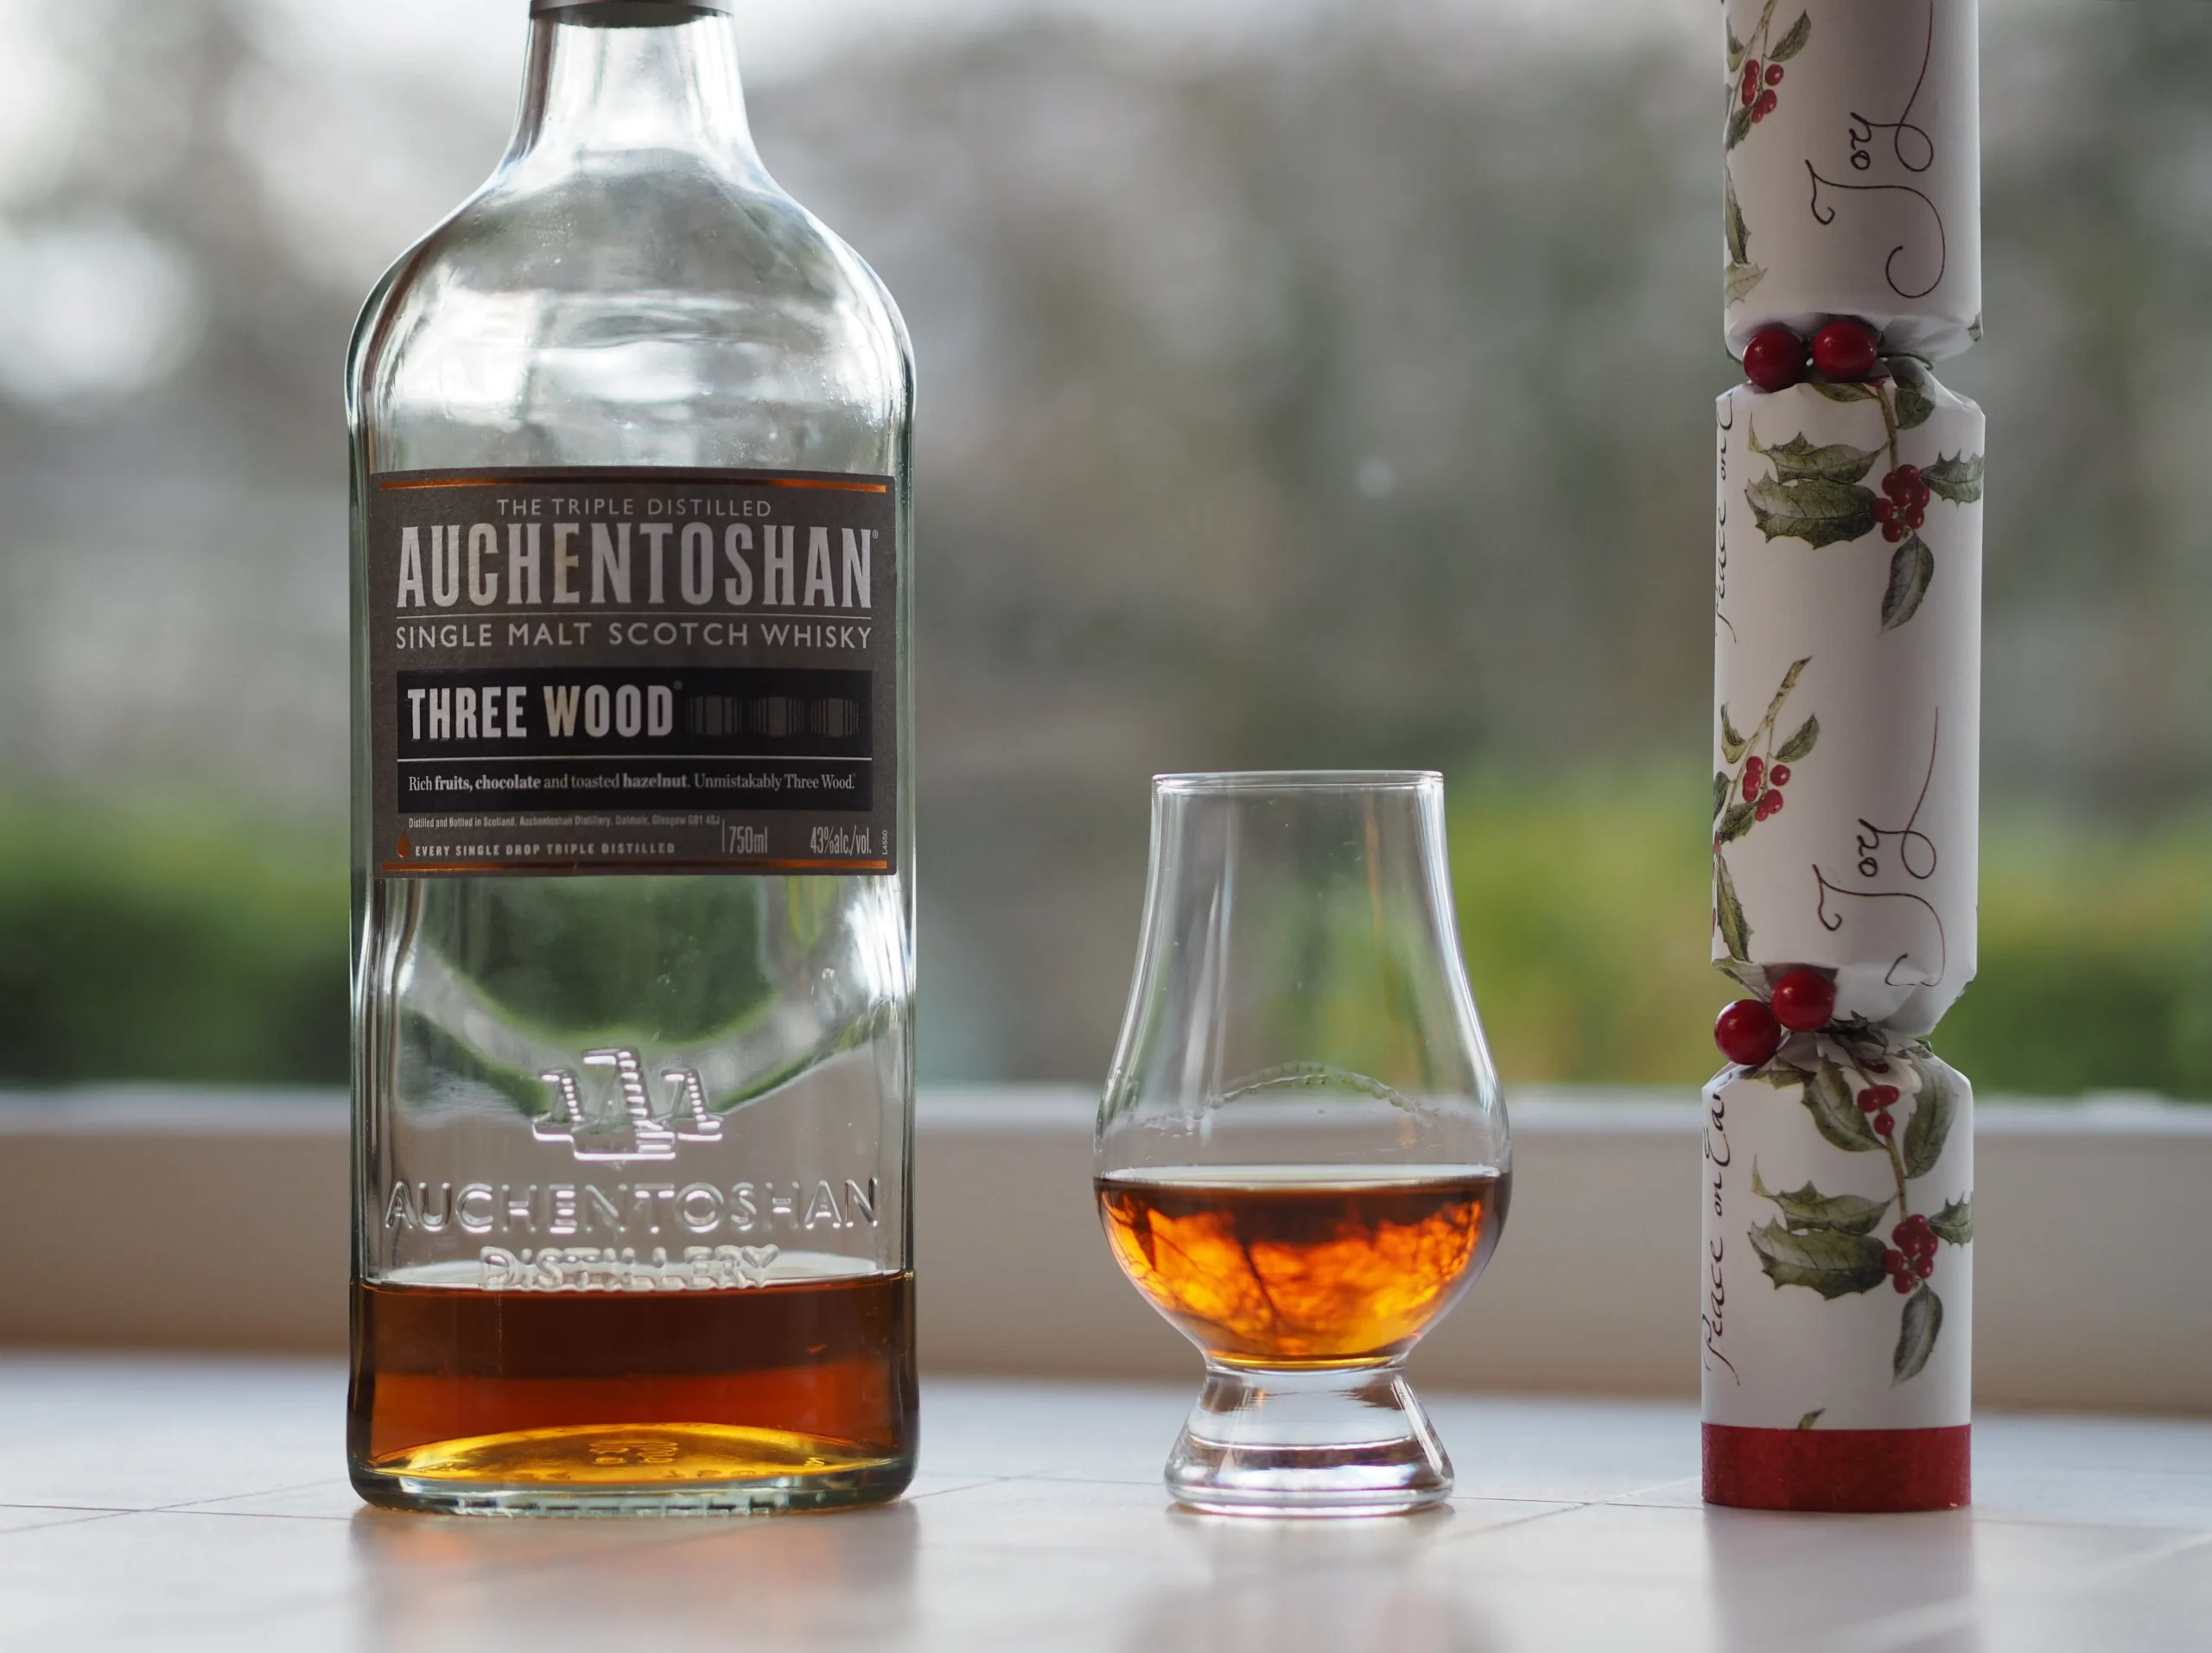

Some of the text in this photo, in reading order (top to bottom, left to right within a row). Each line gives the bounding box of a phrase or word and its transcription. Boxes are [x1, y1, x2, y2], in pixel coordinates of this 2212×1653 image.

[497, 498, 772, 518] THE TRIPLE DISTILLED
[396, 522, 874, 608] AUCHENTOSHAN
[396, 622, 872, 650] SINGLE MALT SCOTCH WHISKY
[407, 683, 674, 741] THREE WOOD
[409, 776, 432, 791] Rich
[435, 775, 474, 792] fruits,
[475, 774, 541, 790] chocolate
[543, 774, 568, 789] and
[571, 773, 620, 789] toasted
[623, 773, 690, 789] hazelnut.
[695, 772, 781, 792] Unmistakably
[784, 773, 819, 789] Three
[409, 817, 434, 828] Distilled
[435, 817, 448, 828] and
[448, 817, 473, 827] Bottled
[474, 817, 481, 827] in
[652, 814, 685, 826] Glasgow
[415, 842, 676, 856] EVERY SINGLE DROP TRIPLE DISTILLED
[729, 826, 768, 854] 750ml
[385, 1179, 879, 1236] AUCHENTOSHAN
[1714, 1171, 1724, 1217] on
[480, 1243, 779, 1292] DISTILLERY
